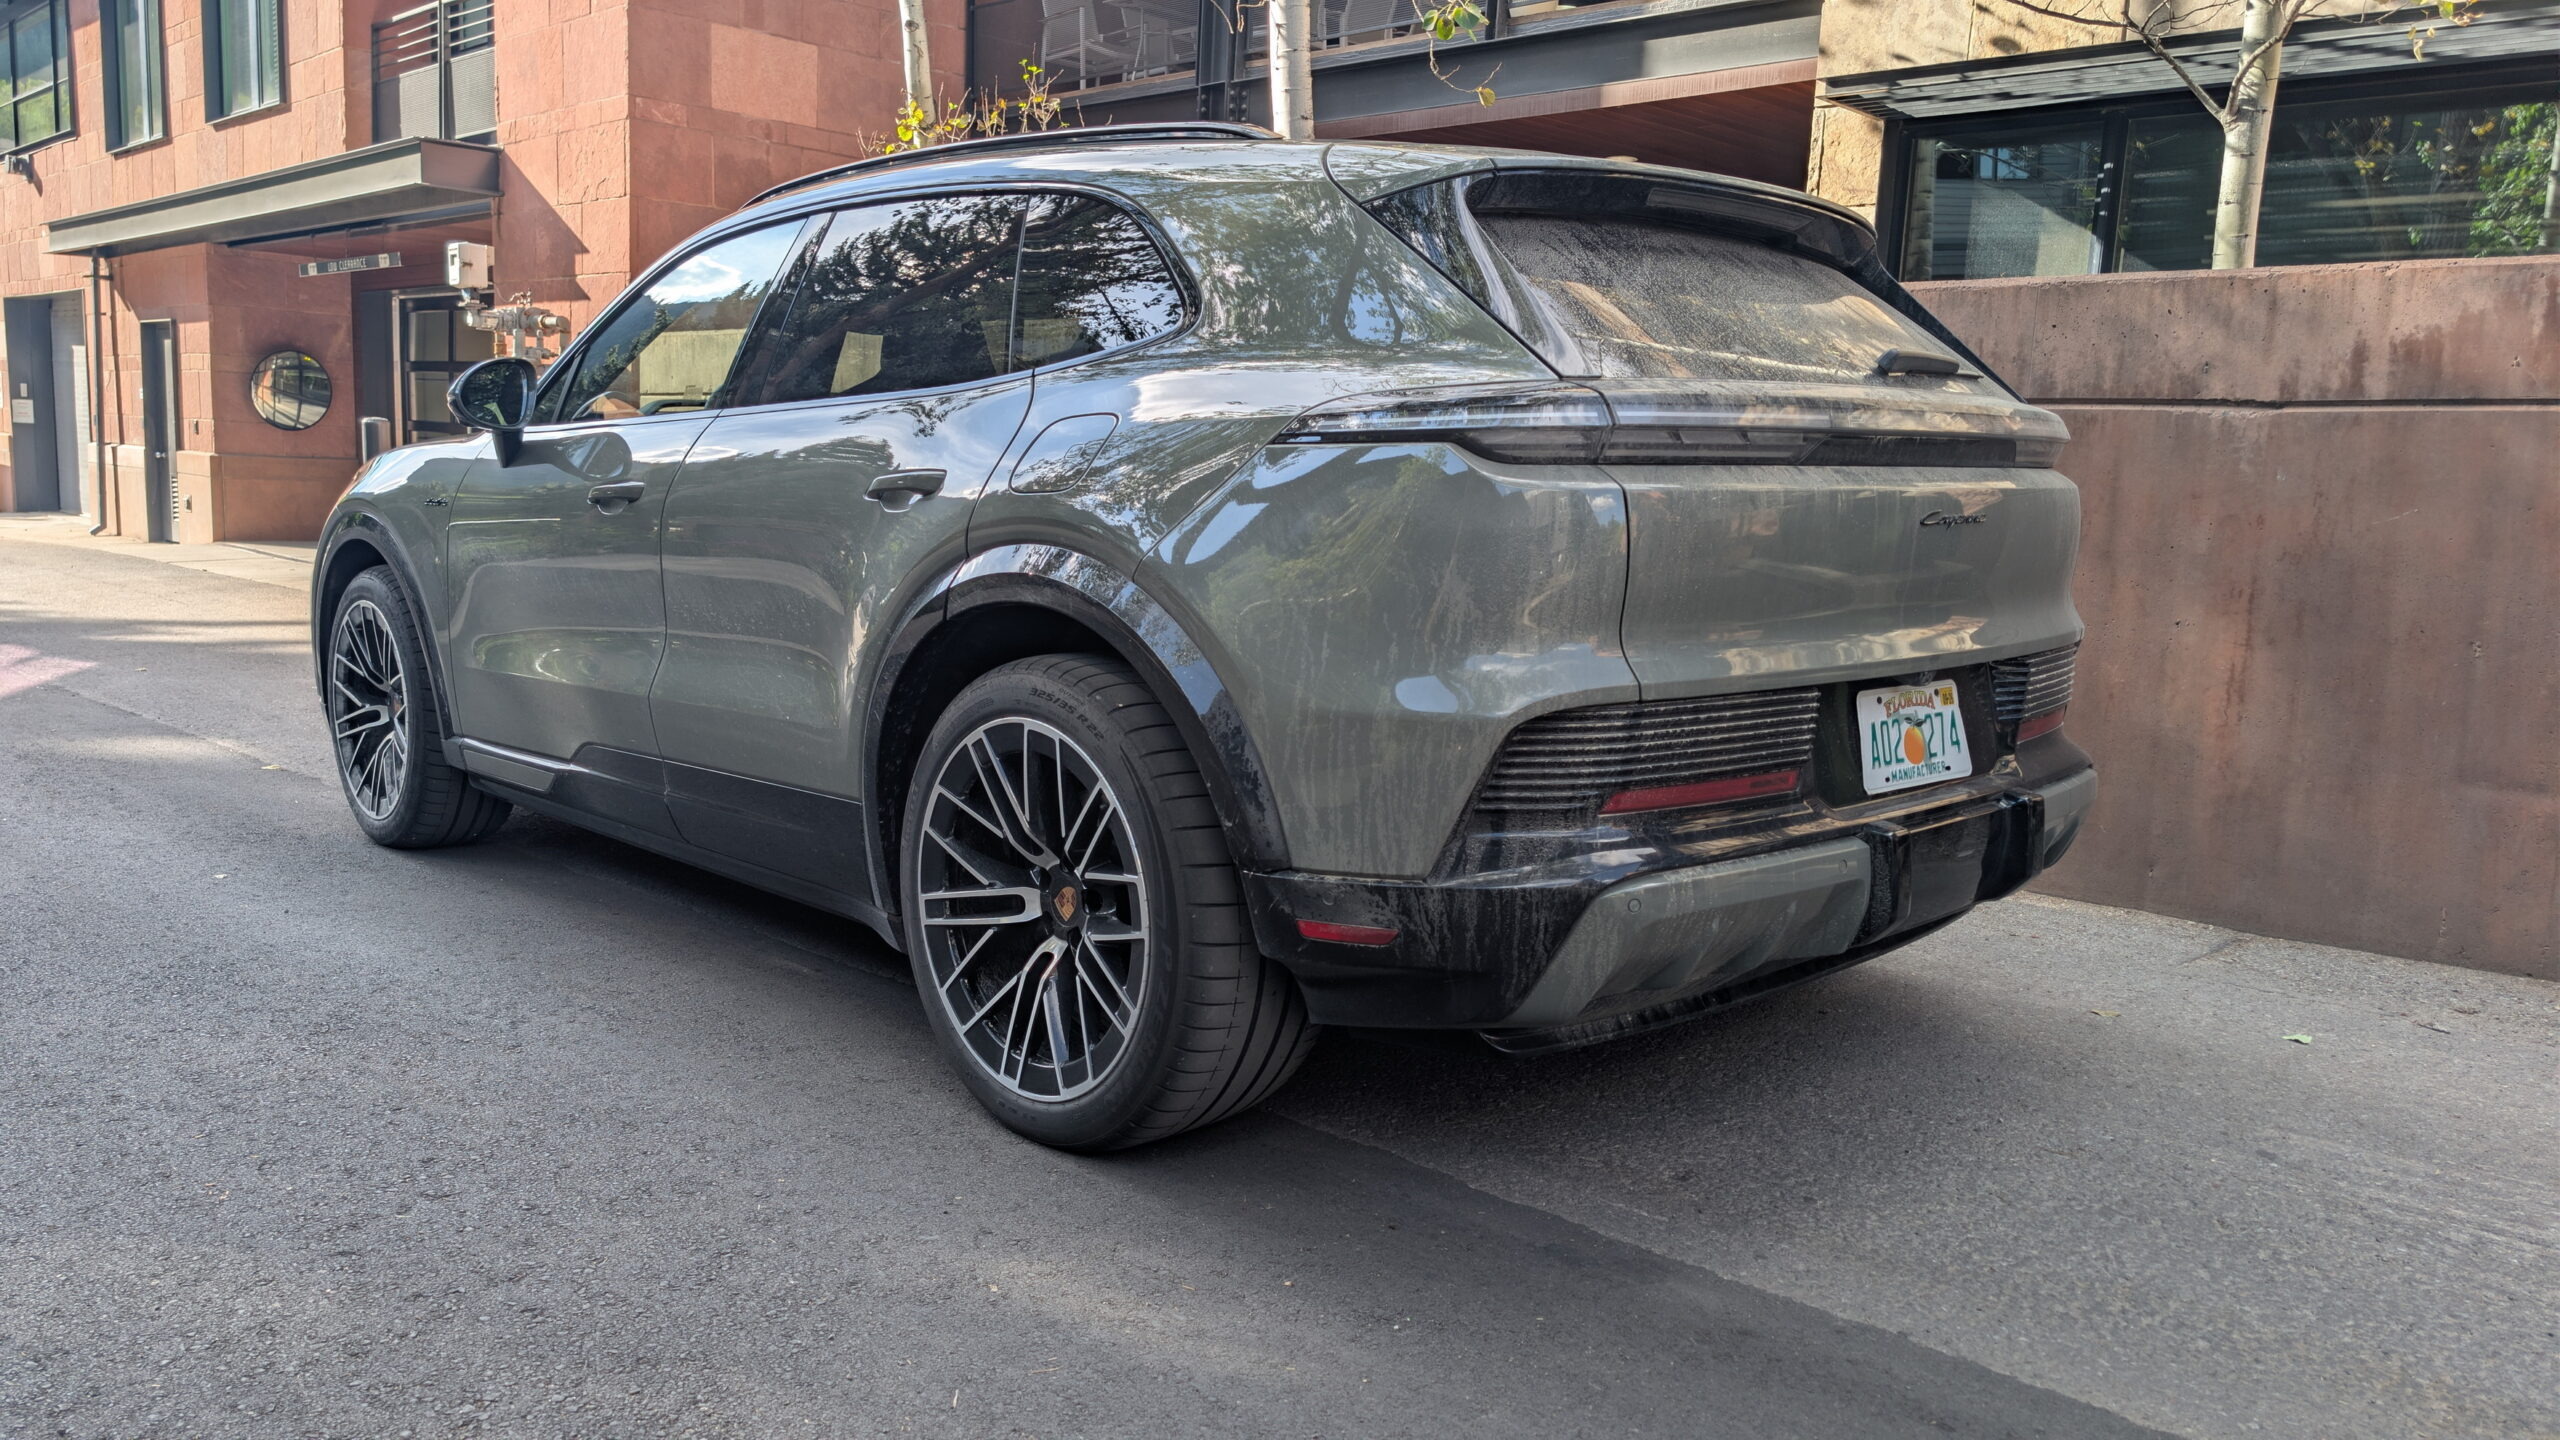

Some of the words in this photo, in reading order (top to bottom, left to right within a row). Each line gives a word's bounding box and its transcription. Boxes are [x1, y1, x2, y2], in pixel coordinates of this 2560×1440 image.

[1029, 687, 1077, 714] 325/35
[1884, 690, 1936, 718] FLORIDA
[1871, 718, 1905, 770] A02
[1923, 709, 1961, 759] 274
[1891, 760, 1947, 783] MANUFACTURER
